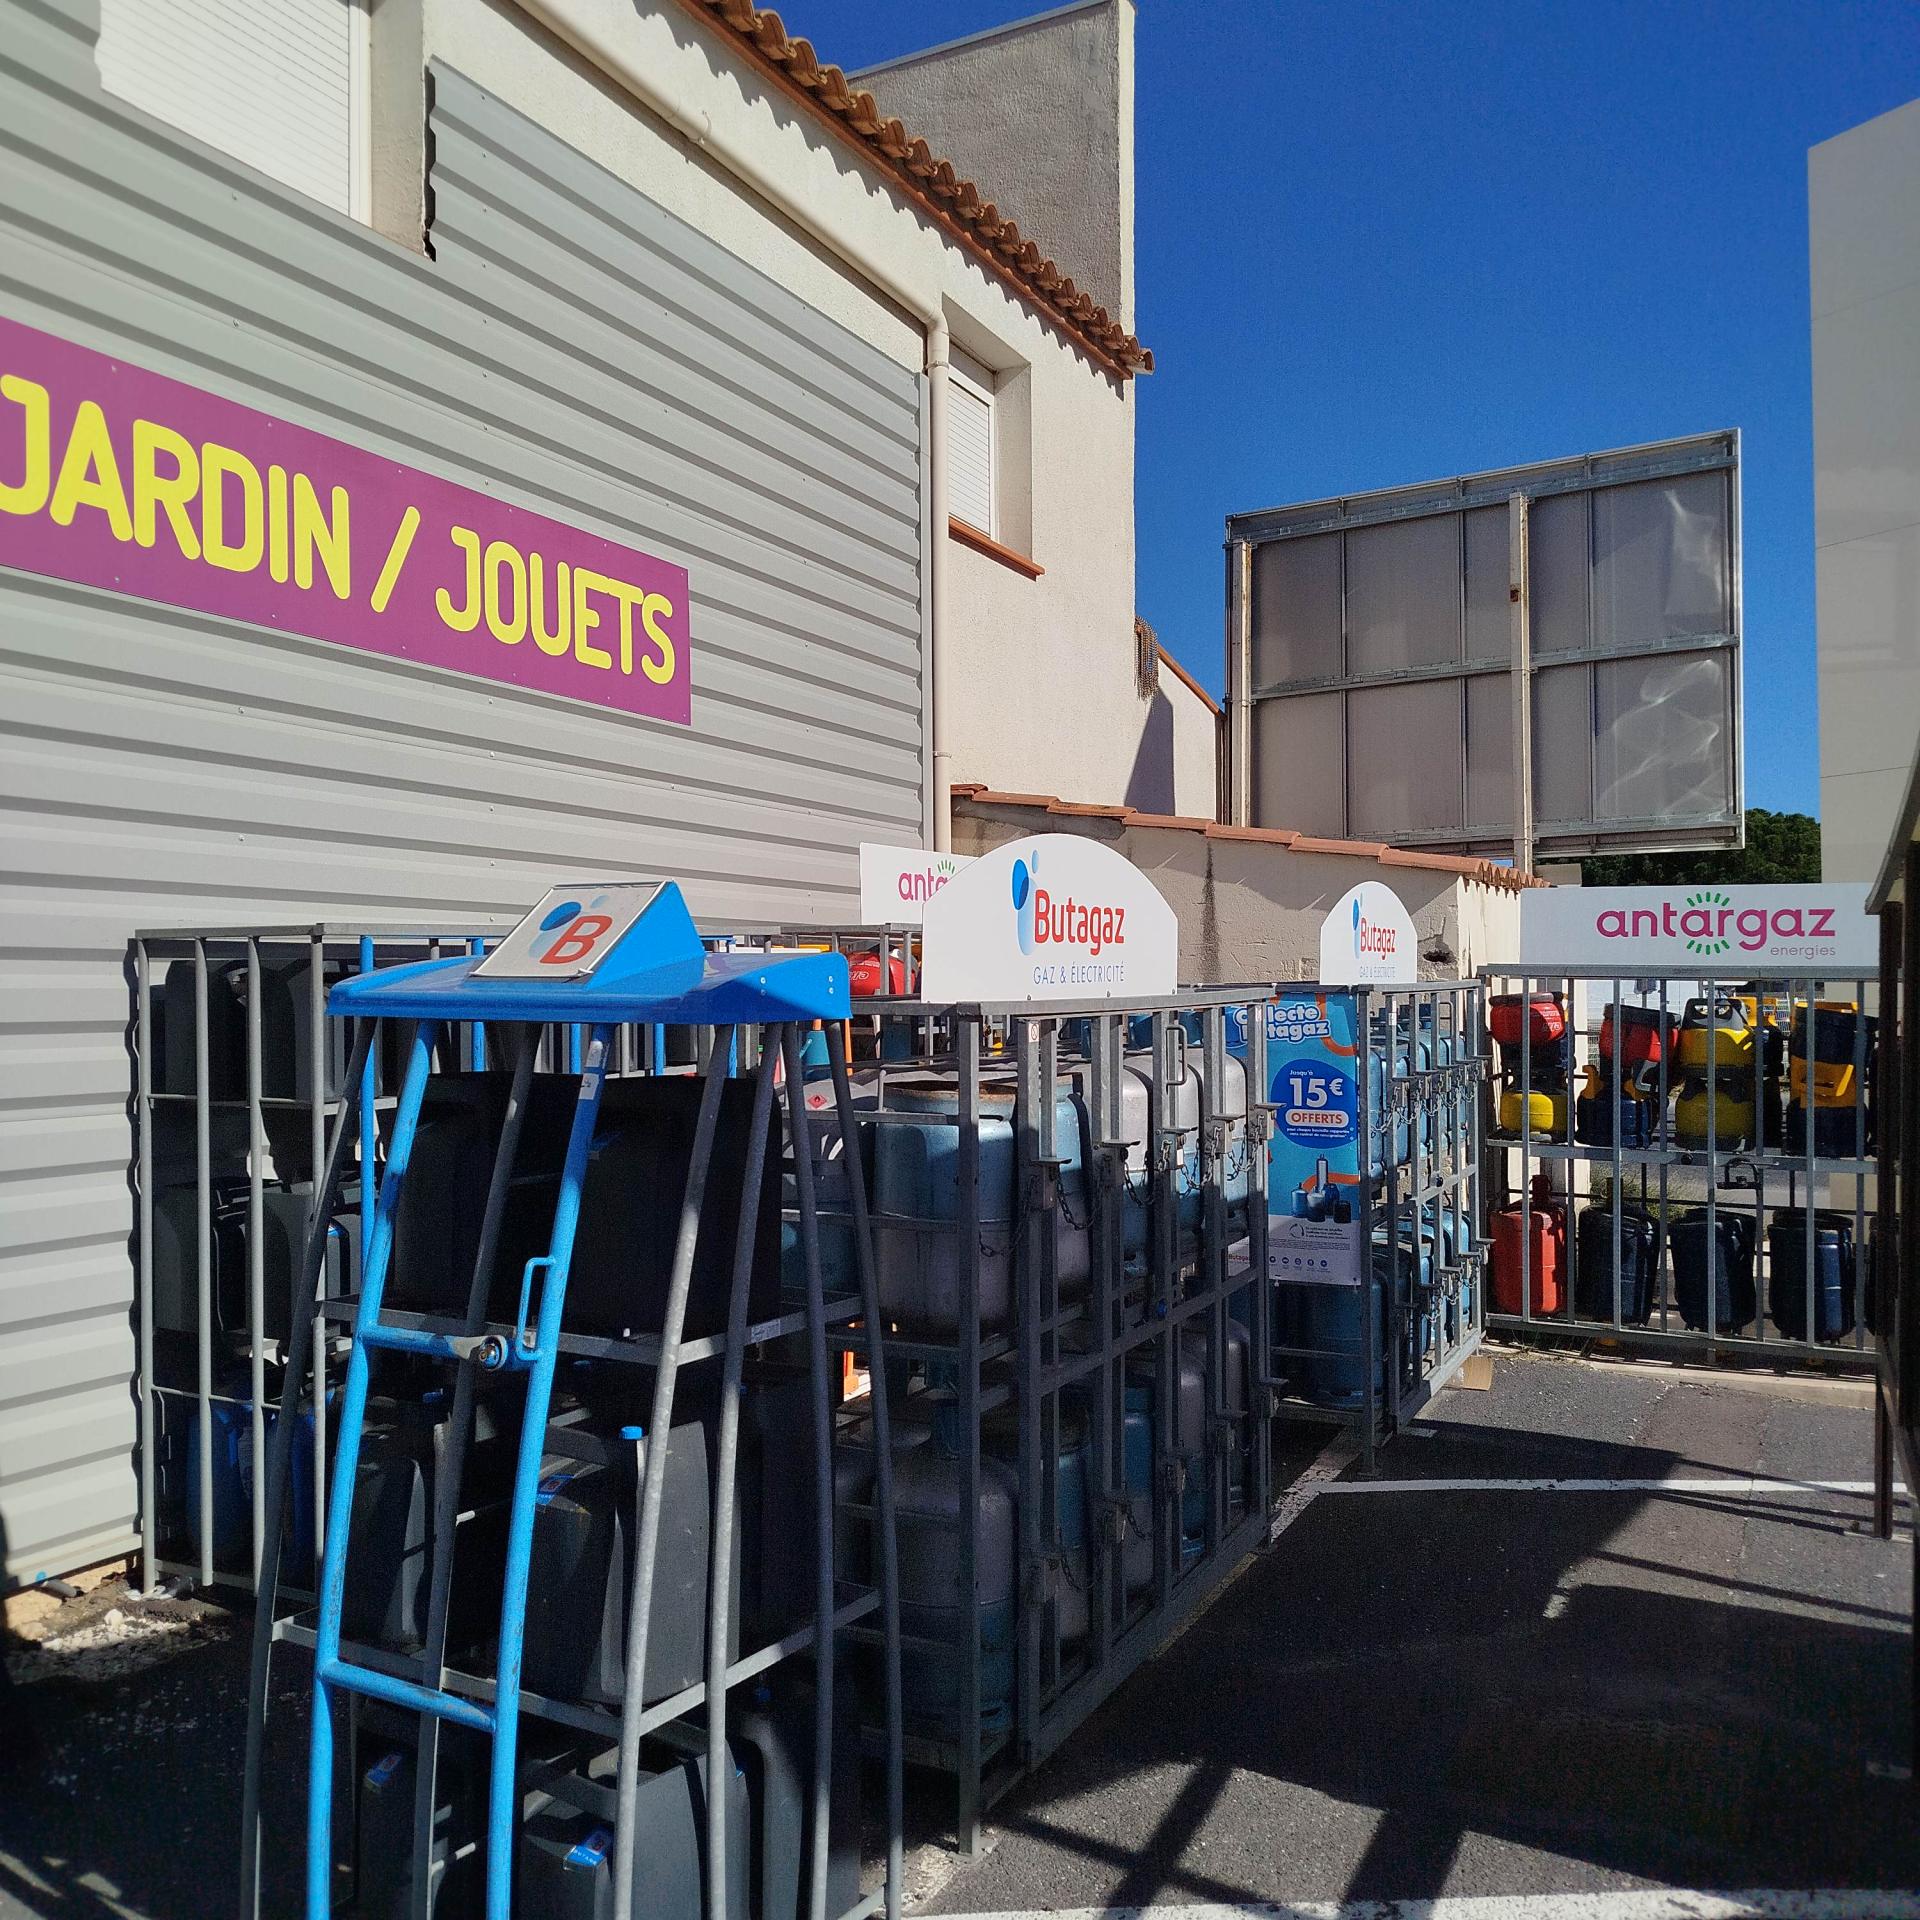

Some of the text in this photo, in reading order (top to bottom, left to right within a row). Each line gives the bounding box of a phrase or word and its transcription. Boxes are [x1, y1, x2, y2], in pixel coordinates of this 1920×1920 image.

[0, 375, 676, 685] JARDIN / JOUETS
[539, 915, 613, 964] B
[1034, 889, 1125, 956] Butagaz
[1360, 917, 1396, 961] Butagaz
[1596, 903, 1836, 951] antargaz
[1033, 961, 1125, 985] GAZ & ÉLECTRICITÉ
[1770, 945, 1836, 960] energies
[1289, 1077, 1344, 1108] 15€
[1291, 1112, 1343, 1124] OFFERTS
